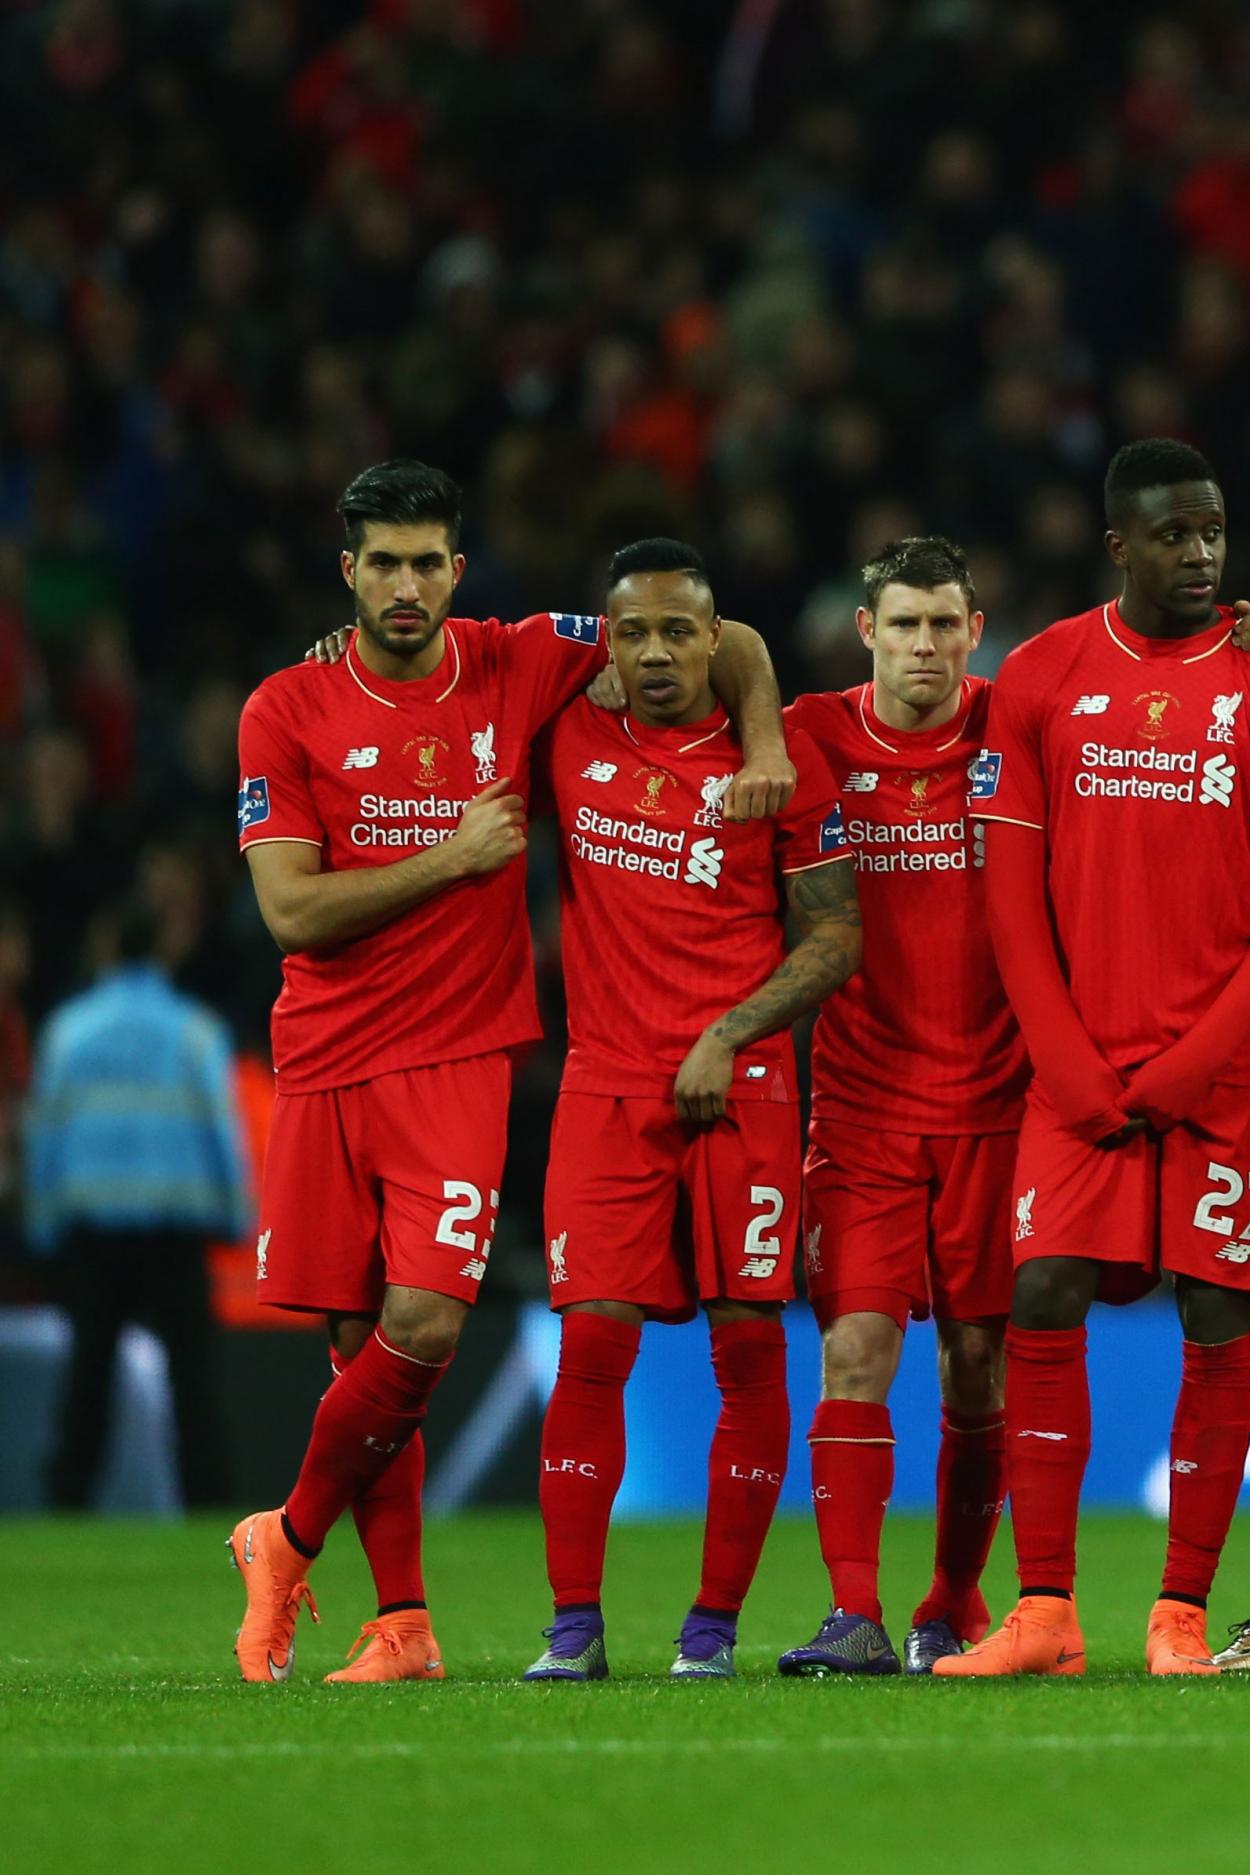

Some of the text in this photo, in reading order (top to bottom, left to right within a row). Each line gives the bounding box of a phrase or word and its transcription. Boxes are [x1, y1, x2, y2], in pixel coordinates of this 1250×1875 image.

[1081, 742, 1196, 773] Standard
[1074, 773, 1194, 802] Chartered
[351, 823, 458, 846] Charter
[576, 806, 685, 853] Standard
[848, 817, 965, 843] Standard
[571, 833, 680, 880] Chartered
[851, 846, 966, 872] hartered
[435, 1180, 499, 1258] 2
[743, 1185, 784, 1255] 2
